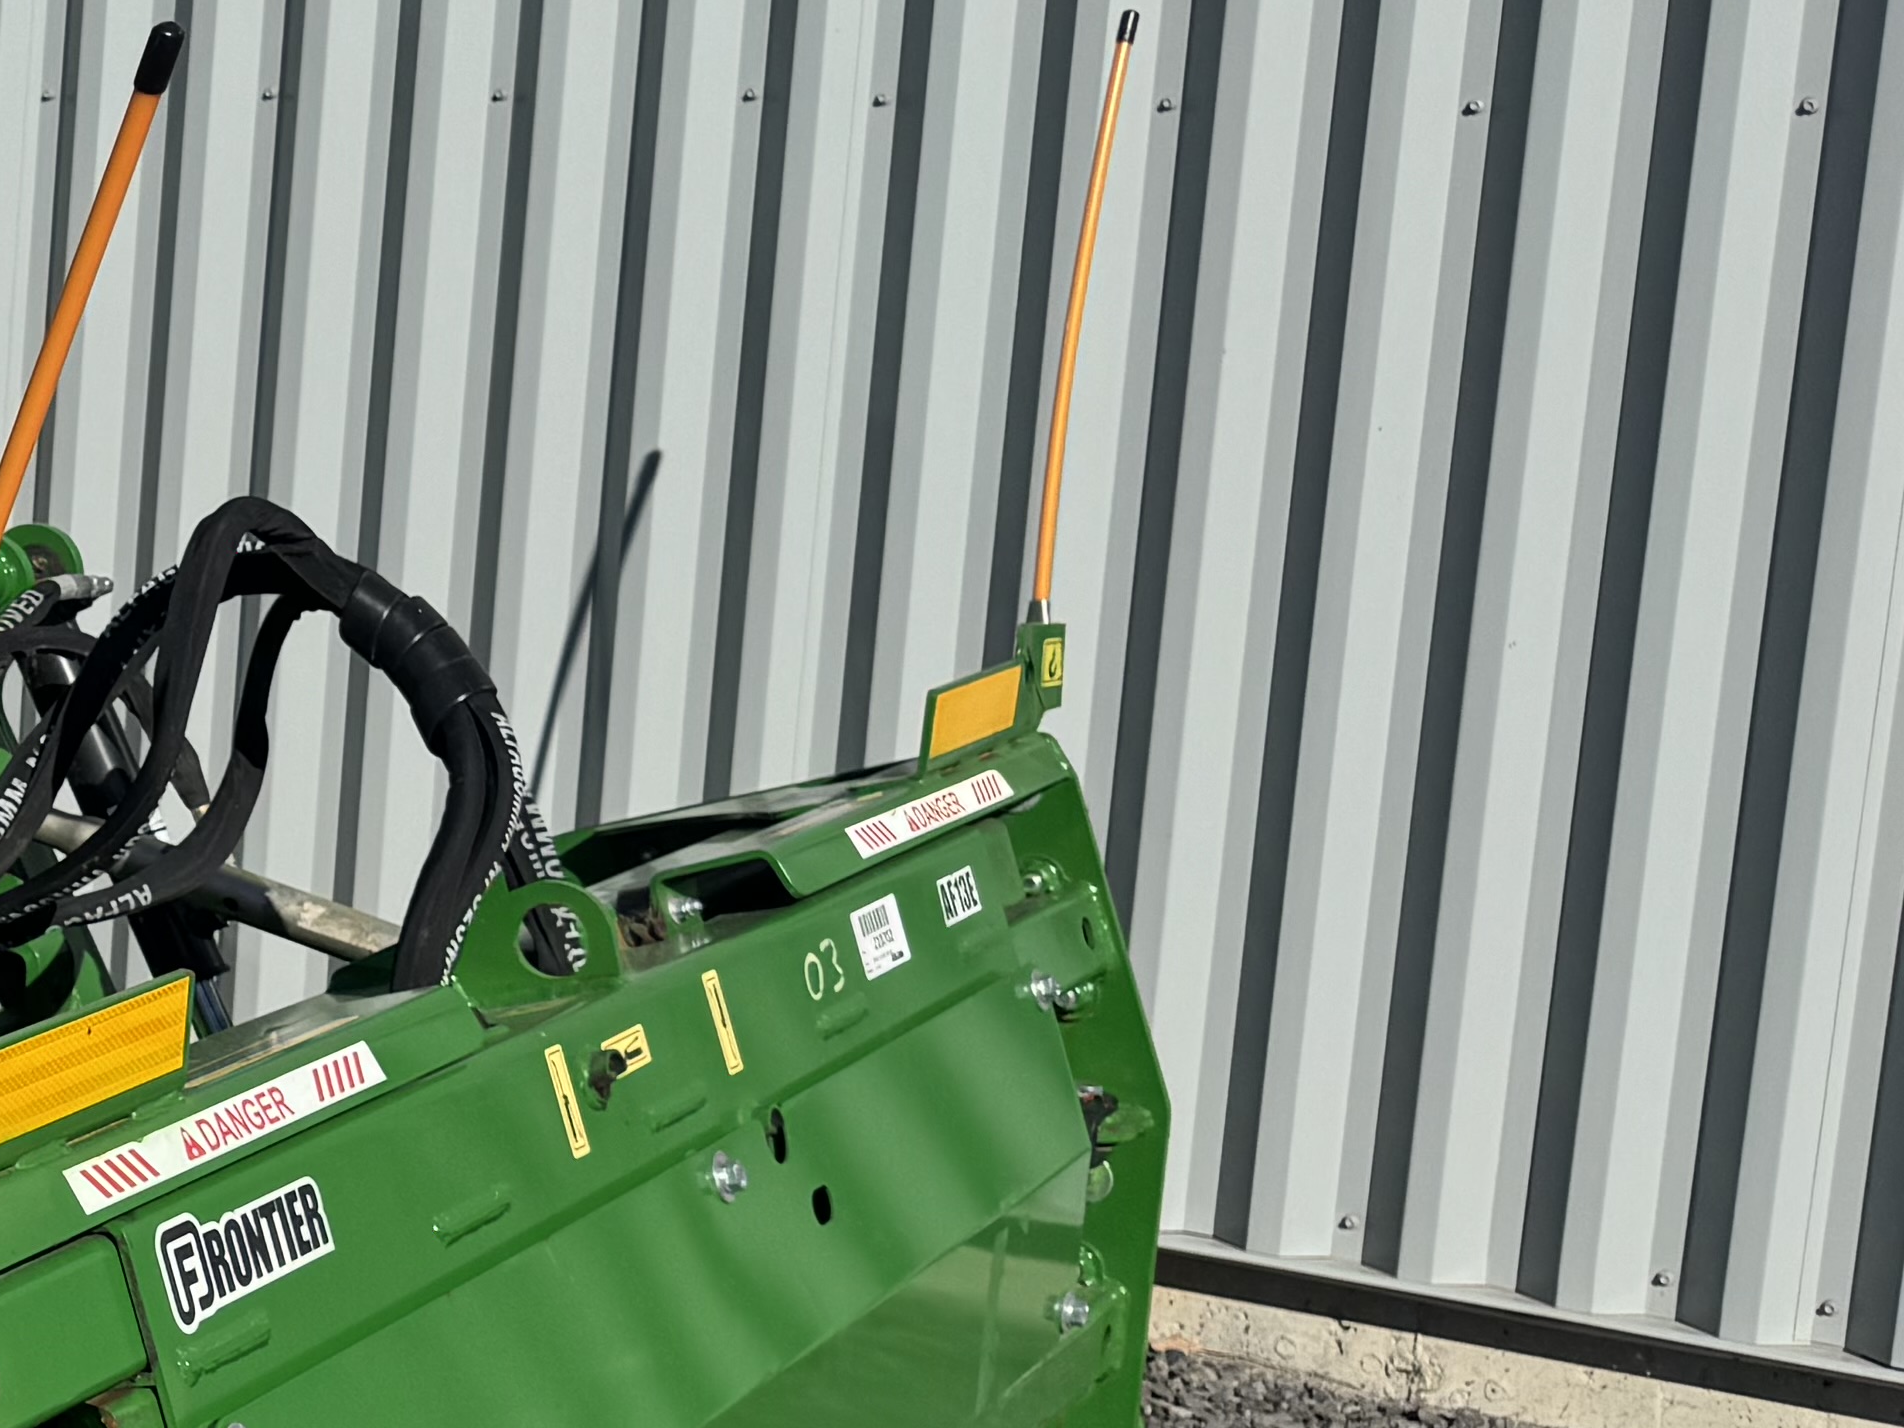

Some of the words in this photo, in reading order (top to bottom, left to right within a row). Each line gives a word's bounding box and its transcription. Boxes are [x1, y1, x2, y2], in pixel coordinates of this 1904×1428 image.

[911, 791, 967, 828] DANGER
[803, 938, 845, 1001] 03
[194, 1086, 295, 1152] DANGER
[160, 1181, 330, 1326] FRONTIER
